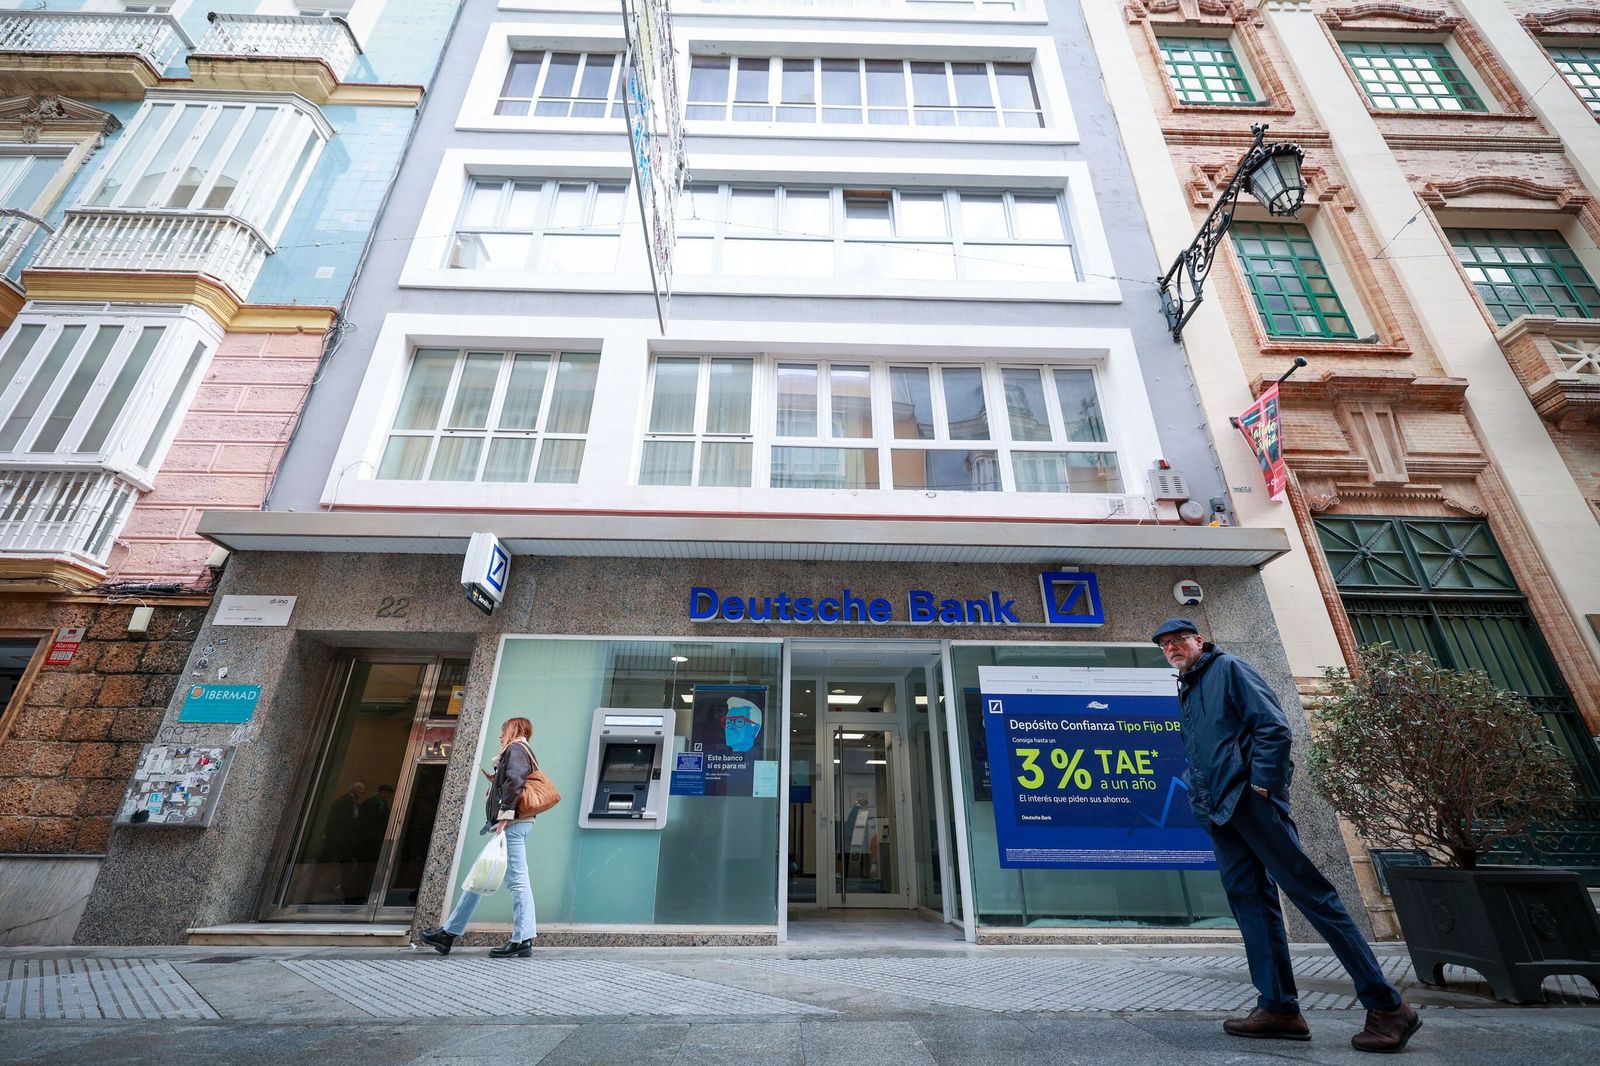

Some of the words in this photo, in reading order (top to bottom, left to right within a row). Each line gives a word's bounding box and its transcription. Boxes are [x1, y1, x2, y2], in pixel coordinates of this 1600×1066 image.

[376, 595, 411, 618] 22
[689, 587, 892, 623] Deutsche
[908, 590, 1019, 625] Bank
[204, 690, 257, 700] IBERMAD
[1009, 719, 1059, 732] Depósito
[1060, 720, 1115, 731] Confianza
[1116, 720, 1141, 733] Tipo
[1143, 720, 1163, 734] Fijo
[1165, 721, 1181, 732] DB
[1012, 736, 1033, 744] Consiga
[722, 754, 744, 762] banco
[1100, 780, 1108, 789] a
[1112, 780, 1128, 790] un
[1132, 777, 1157, 790] año
[1019, 794, 1026, 802] El
[1027, 794, 1052, 803] interés
[1068, 795, 1089, 804] piden
[1102, 795, 1132, 804] ahorros.
